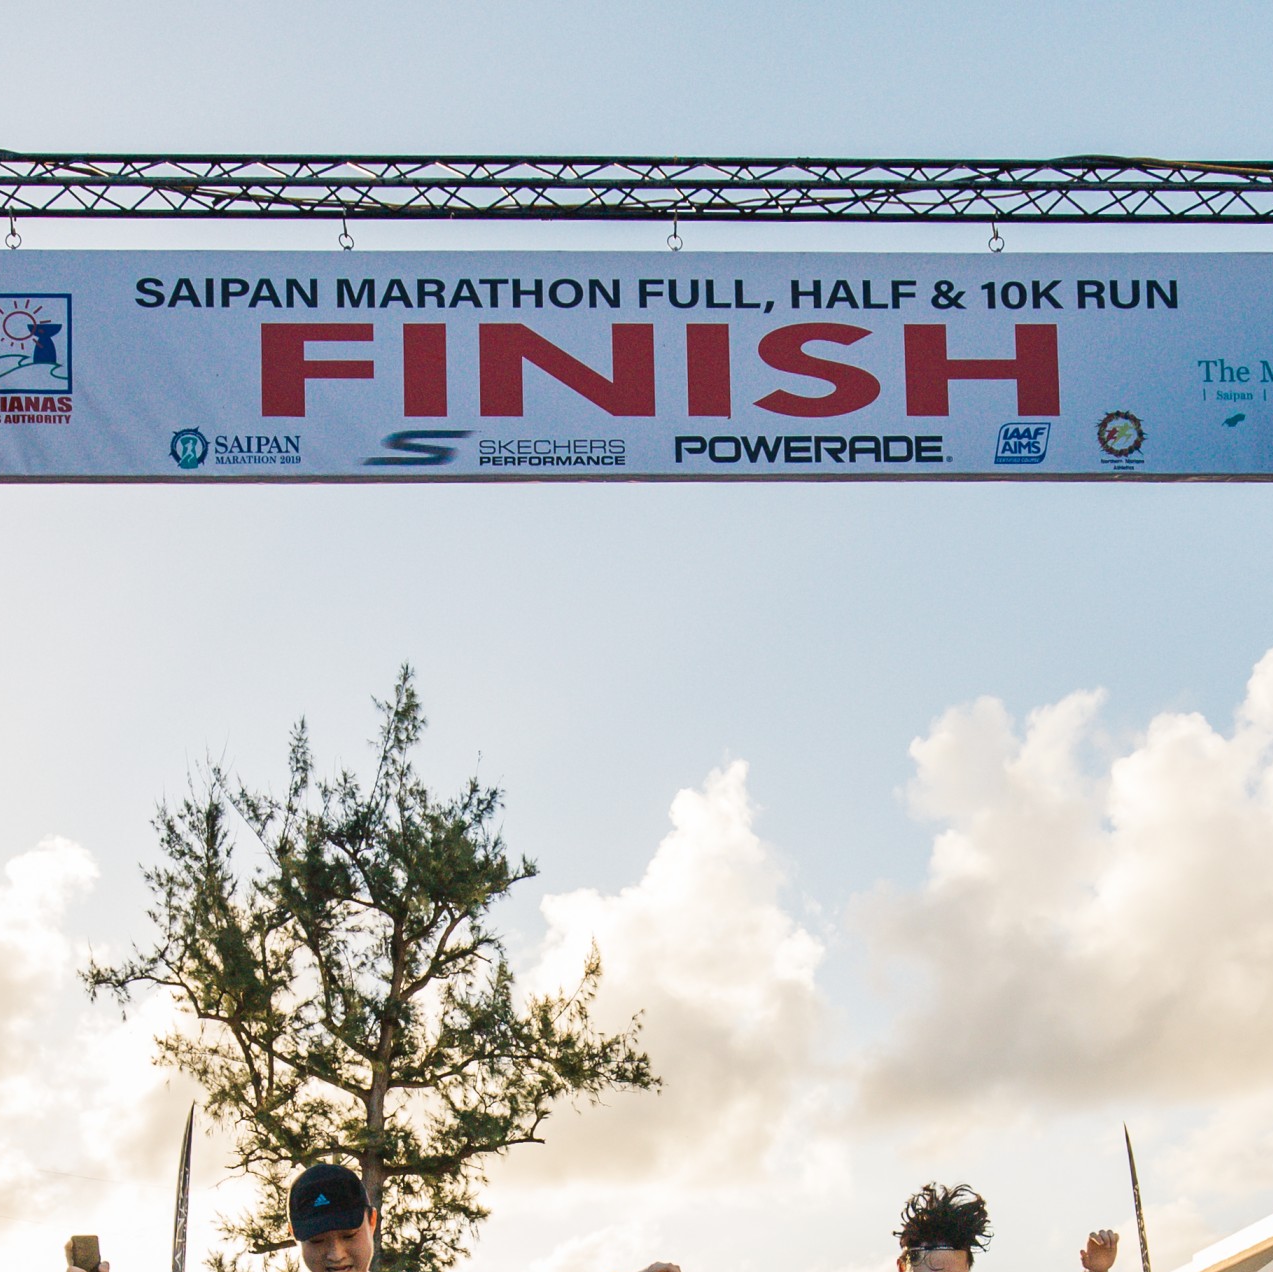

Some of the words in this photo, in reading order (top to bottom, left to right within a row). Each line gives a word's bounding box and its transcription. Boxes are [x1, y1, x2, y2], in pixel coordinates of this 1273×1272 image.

[135, 277, 320, 309] SAIPAN
[336, 277, 621, 309] MARATHON
[639, 279, 774, 315] FULL,
[791, 279, 917, 309] HALF
[930, 279, 967, 310] &
[980, 280, 1065, 309] 10K
[1076, 280, 1179, 309] RUN
[260, 321, 1061, 418] FINISH
[1197, 360, 1250, 383] The
[1215, 390, 1253, 402] Saipan
[4, 414, 72, 425] AUTHORITY
[1003, 427, 1047, 440] IAAF
[214, 435, 302, 454] SAIPAN
[478, 438, 626, 455] SKECHERS
[674, 435, 944, 464] POWERADE
[1001, 441, 1041, 454] AIMS
[216, 455, 277, 465] MARATHON
[280, 455, 302, 464] 2019
[478, 454, 626, 466] PERFORMANCE
